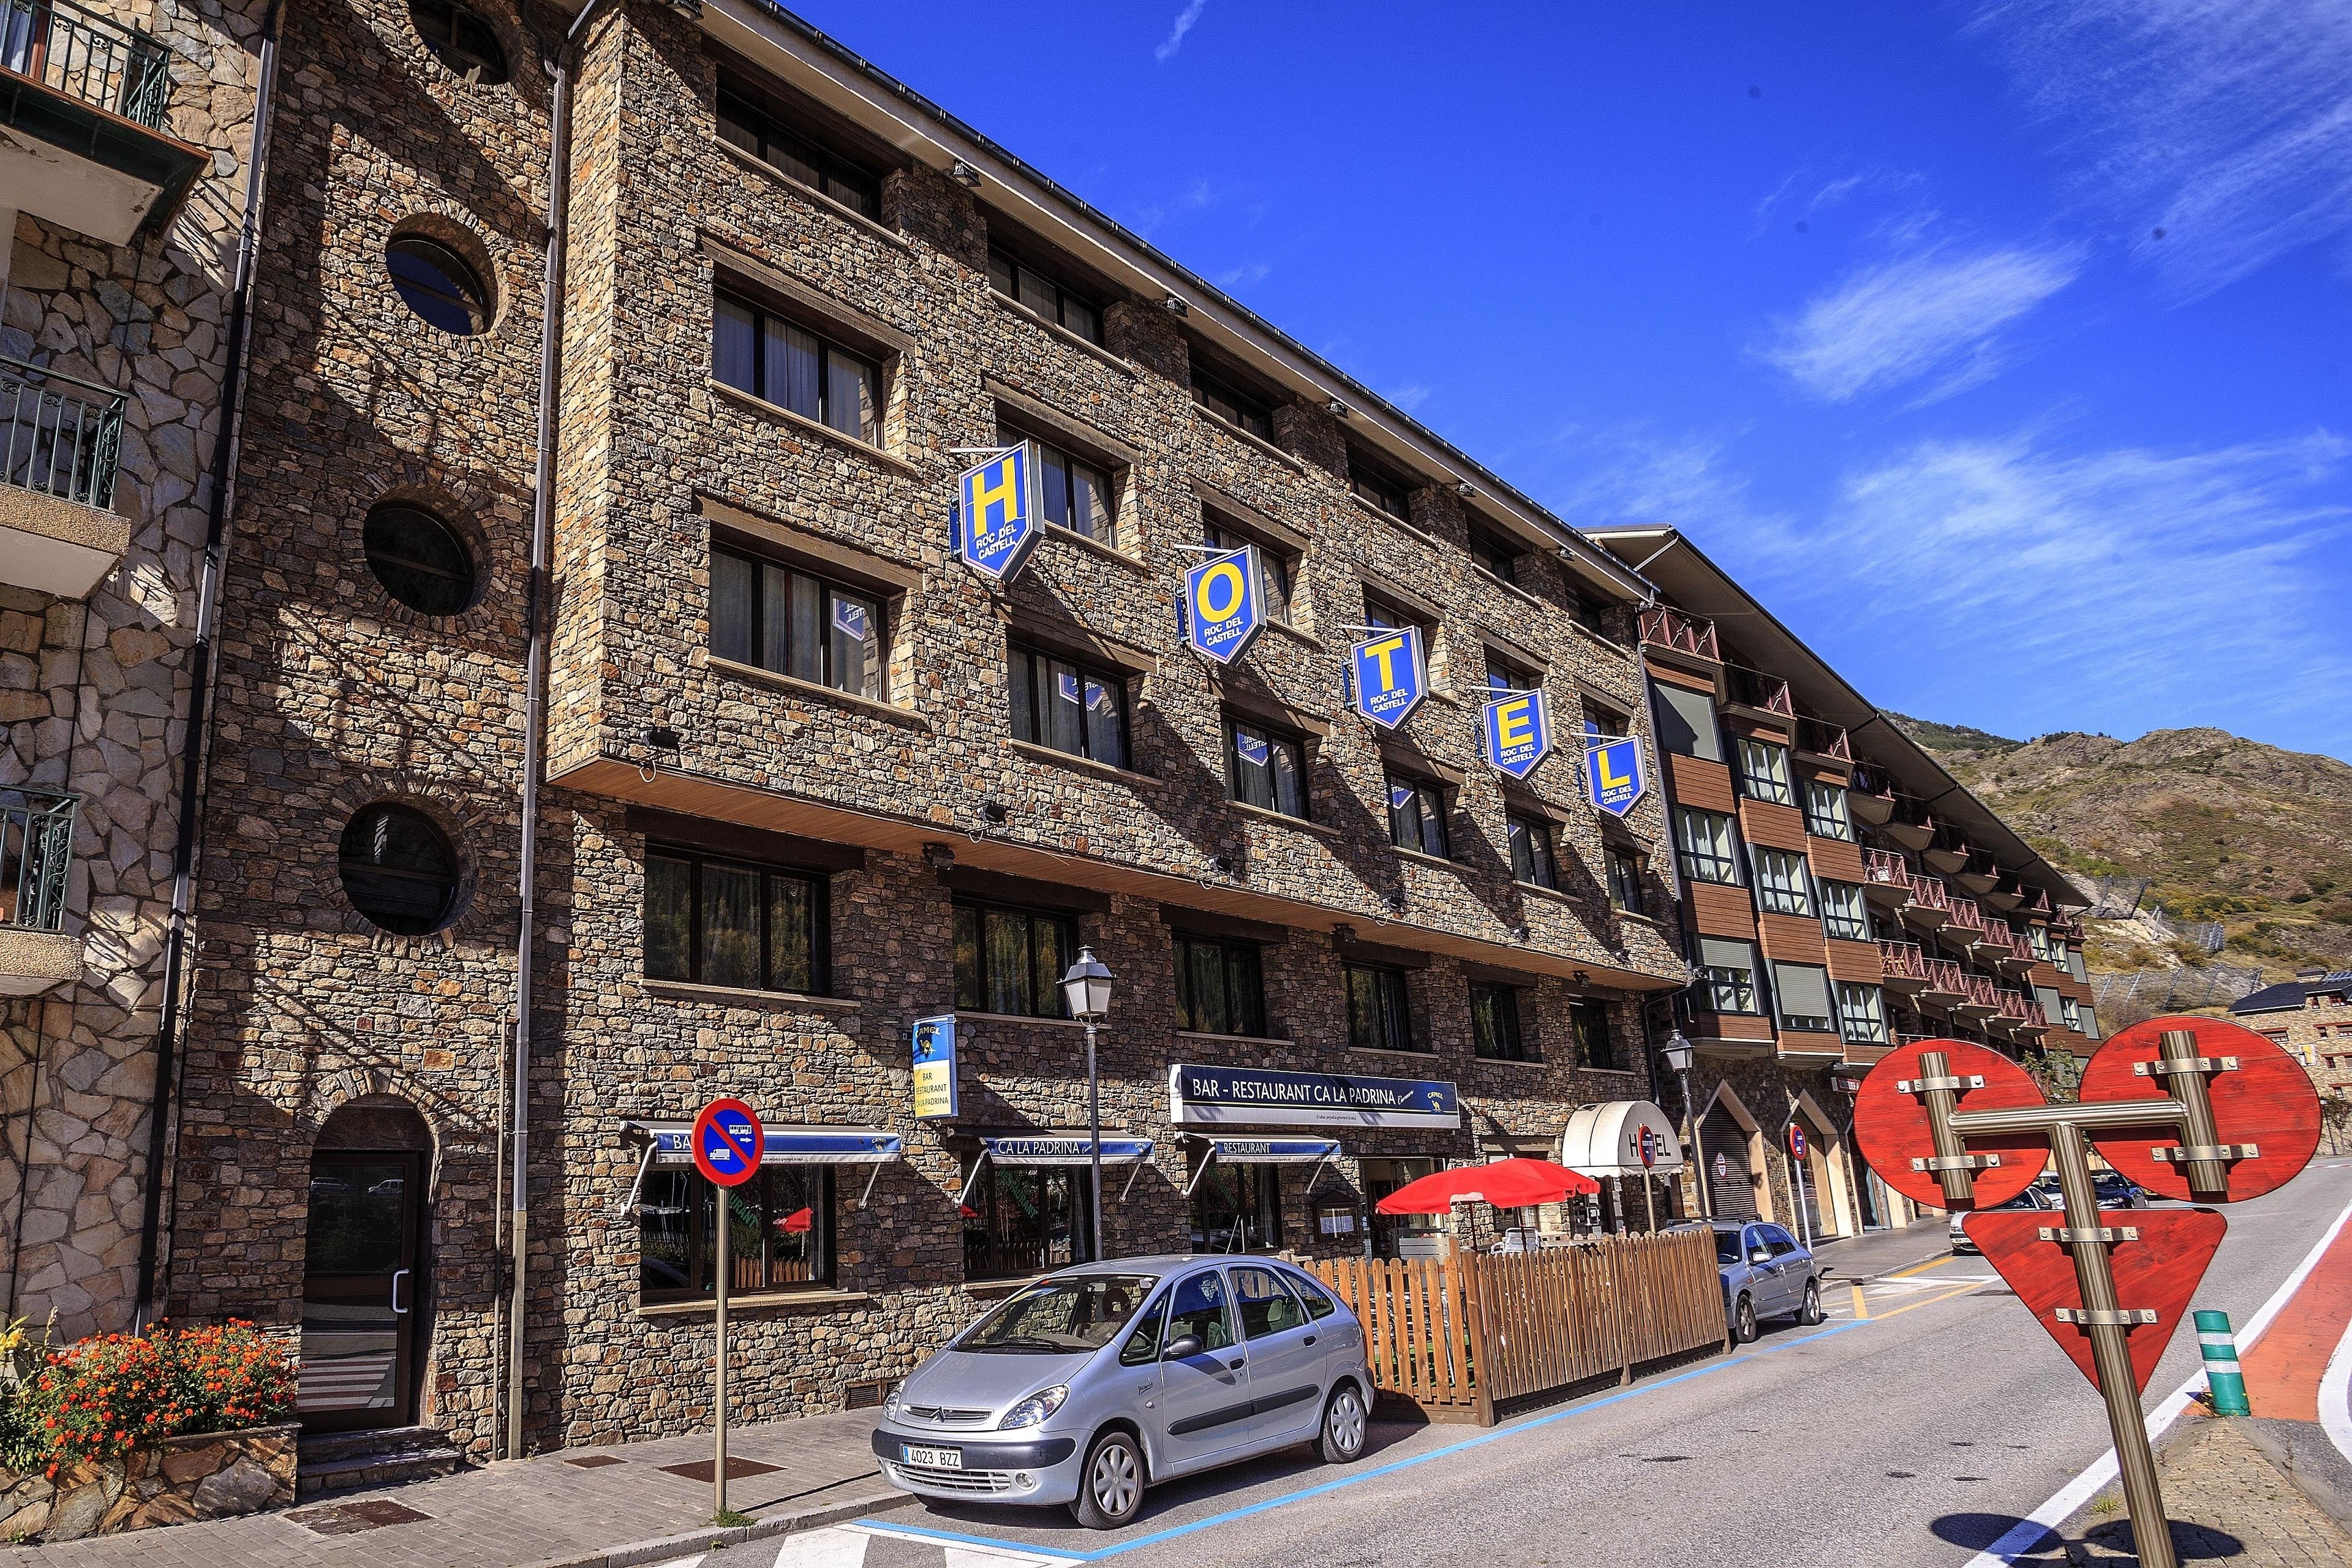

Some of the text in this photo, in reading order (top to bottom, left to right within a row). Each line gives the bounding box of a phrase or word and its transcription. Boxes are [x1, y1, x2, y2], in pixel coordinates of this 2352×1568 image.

[972, 455, 1017, 538] H
[976, 524, 1017, 550] ROC DEL
[978, 536, 1017, 560] CASTELL
[1197, 562, 1245, 624] O
[1204, 616, 1243, 638] ROC DEL
[1206, 627, 1243, 646] CASTELL
[1365, 636, 1404, 692] T
[1370, 688, 1408, 706] ROC DEL
[1373, 697, 1407, 714] CASTELL
[1496, 698, 1534, 749] E
[1500, 743, 1536, 758] ROC DEL
[1502, 752, 1535, 766] CASTELL
[1597, 749, 1630, 790] L
[1600, 785, 1634, 799] ROC DEL
[1603, 792, 1633, 805] CASTELL
[915, 1026, 941, 1038] CAMEL
[922, 1072, 932, 1081] BAR
[916, 1084, 947, 1096] RESTAURANT
[1193, 1078, 1219, 1098] BAR
[1232, 1080, 1311, 1101] RESTAURANT
[1314, 1085, 1331, 1102] CA
[1333, 1086, 1348, 1103] LA
[1349, 1087, 1396, 1105] PADRINA
[1427, 1091, 1444, 1100] CAMEL
[925, 1097, 949, 1106] PADRINA
[673, 1134, 692, 1150] BA
[998, 1141, 1014, 1155] CA
[1017, 1141, 1030, 1155] LA
[1033, 1141, 1080, 1155] PADRINA
[1224, 1142, 1270, 1154] RESTAURANT
[1628, 1133, 1672, 1157] HEL
[728, 1188, 759, 1228] AURANT
[911, 1450, 933, 1464] 4023
[940, 1453, 959, 1467] BZZ
